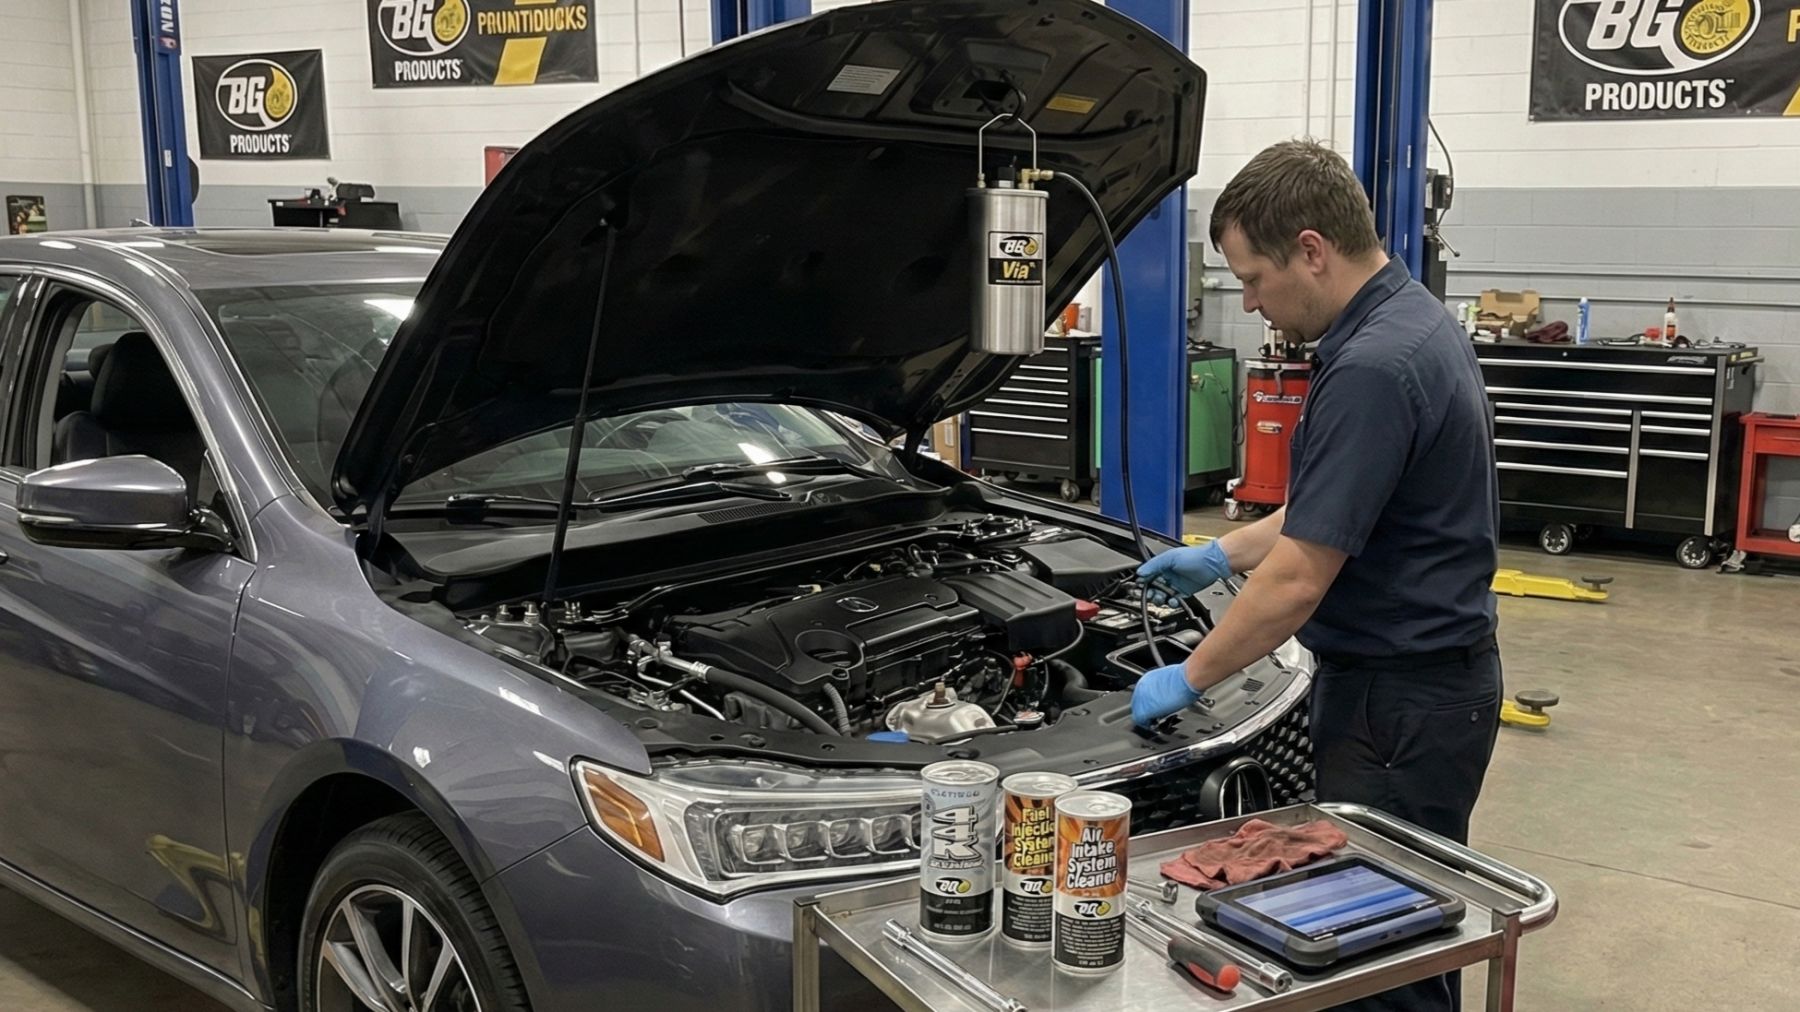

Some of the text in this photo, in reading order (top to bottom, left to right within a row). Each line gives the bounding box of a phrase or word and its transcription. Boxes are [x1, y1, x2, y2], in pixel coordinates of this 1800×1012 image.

[381, 0, 435, 40] BG
[1572, 0, 1685, 50] BG
[395, 59, 461, 81] PRODUCTS
[220, 76, 267, 114] BG
[1585, 79, 1727, 110] PRODUCTS
[229, 134, 290, 153] PRODUCTS
[1003, 261, 1030, 279] Via
[1082, 827, 1102, 842] Air
[1071, 841, 1114, 858] Intake
[1068, 856, 1116, 873] System
[1067, 870, 1117, 888] Cleaner
